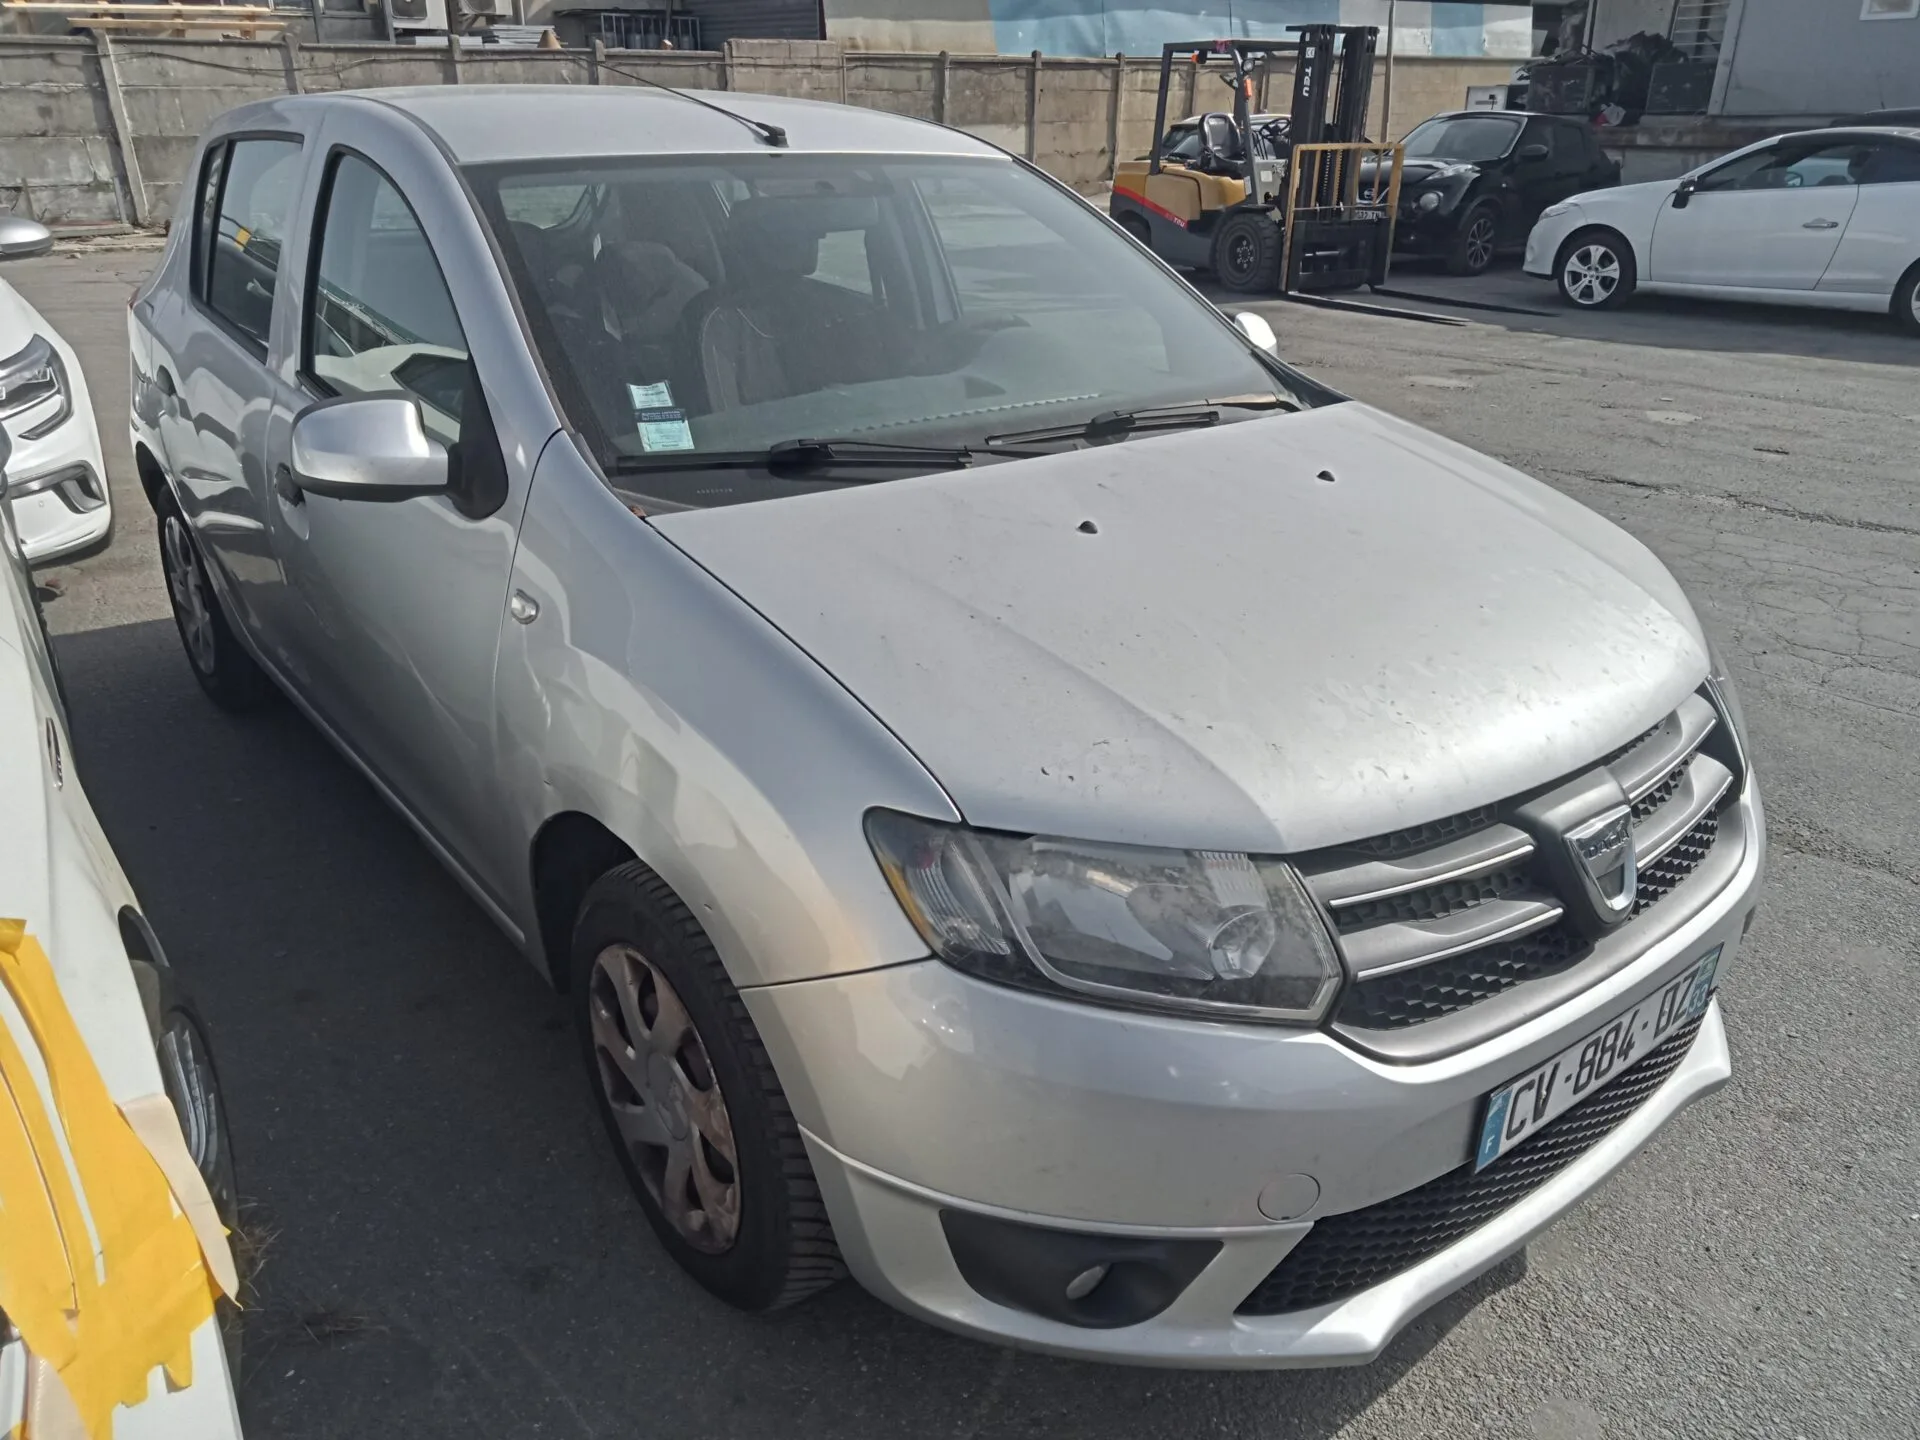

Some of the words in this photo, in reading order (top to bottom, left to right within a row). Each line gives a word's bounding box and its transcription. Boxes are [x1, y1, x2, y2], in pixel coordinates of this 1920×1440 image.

[1302, 66, 1312, 97] TEU
[1588, 827, 1630, 860] DACIA
[1483, 1134, 1496, 1155] F
